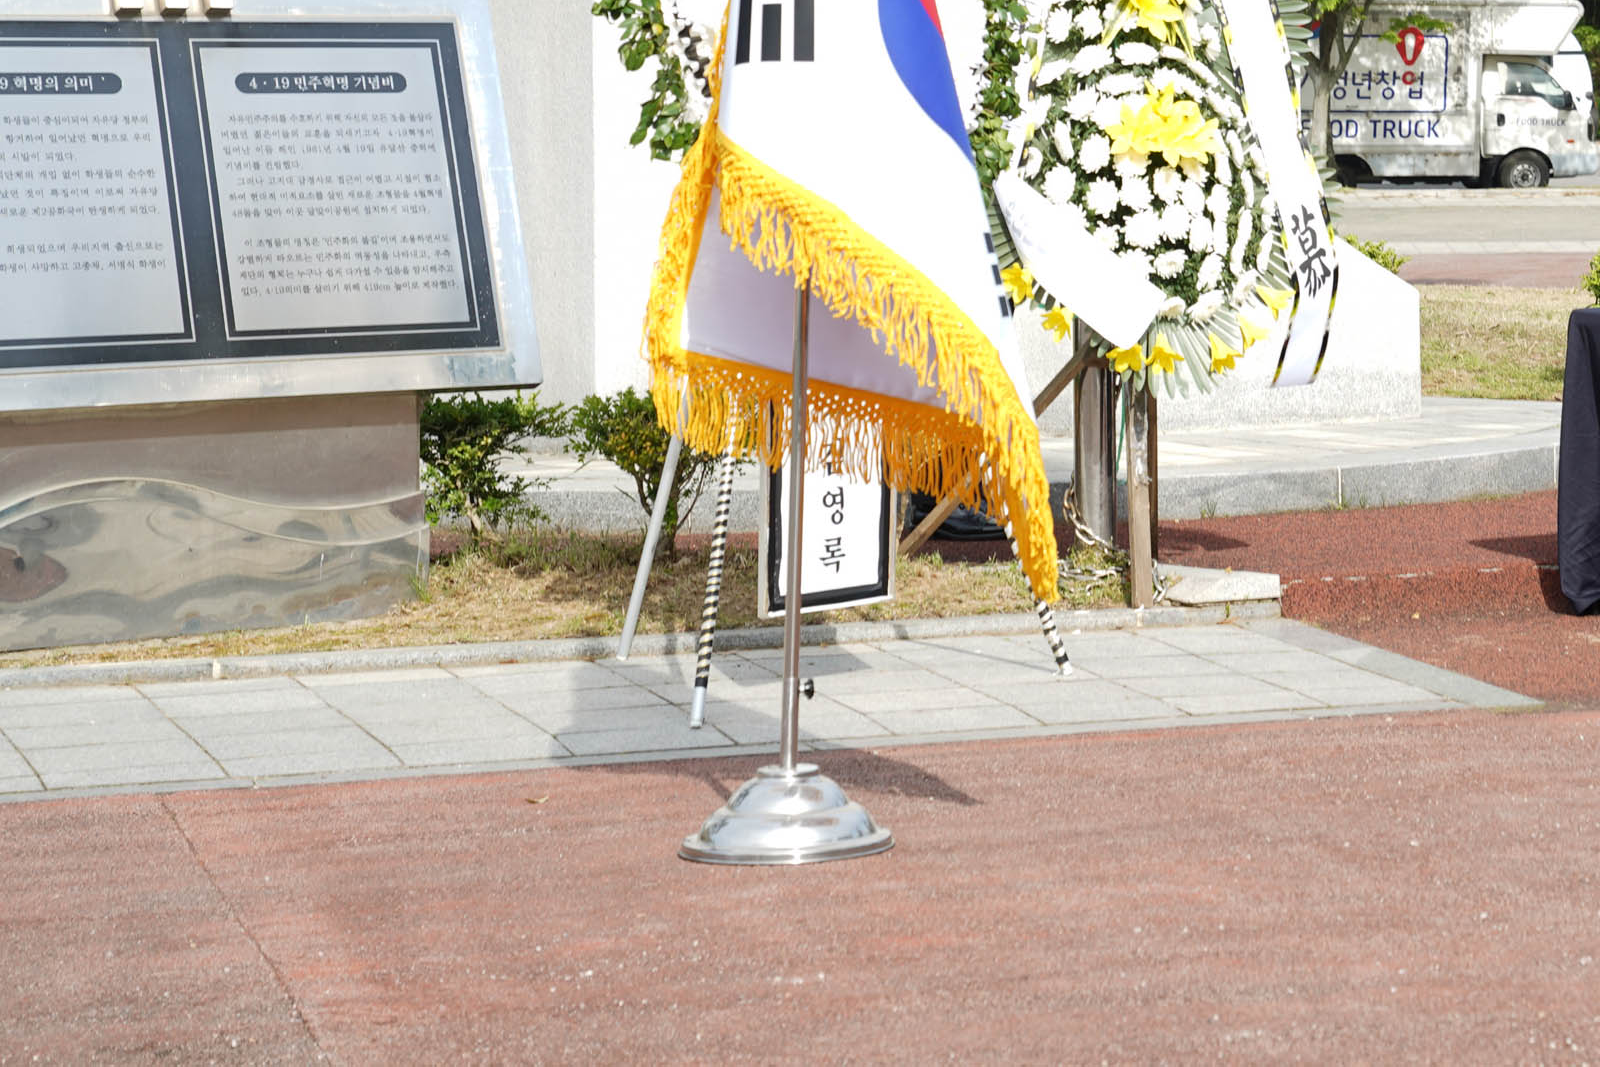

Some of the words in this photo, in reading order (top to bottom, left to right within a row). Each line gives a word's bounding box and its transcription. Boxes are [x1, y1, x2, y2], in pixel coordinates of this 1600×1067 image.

[13, 75, 59, 92] 혁명의
[64, 75, 93, 92] 의미
[249, 77, 258, 91] 4
[273, 77, 290, 90] 19
[294, 75, 349, 92] 민주혁명
[354, 75, 395, 92] 기념비
[1301, 119, 1359, 139] FOD
[1369, 119, 1441, 139] TRUCK
